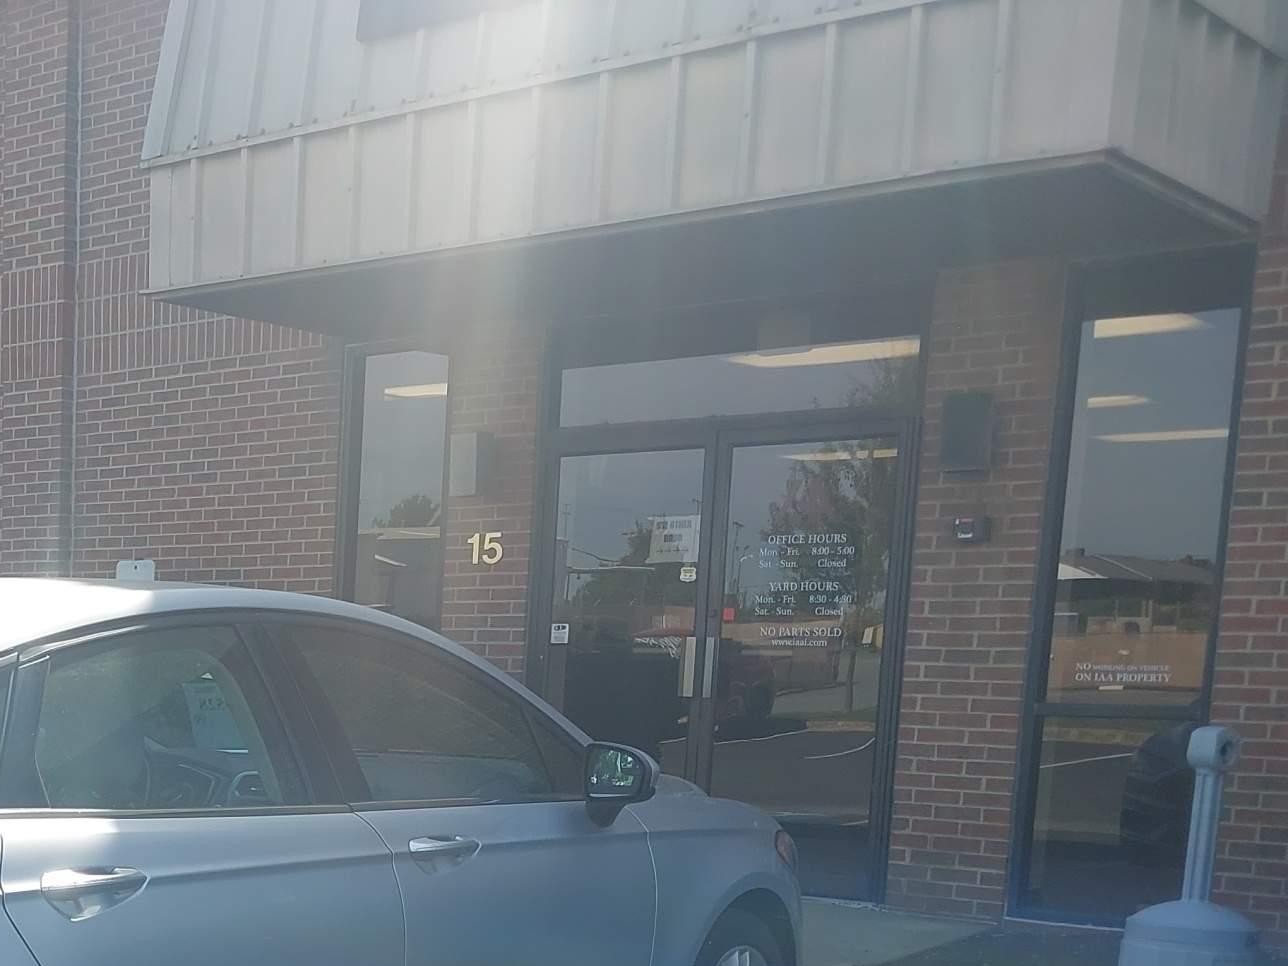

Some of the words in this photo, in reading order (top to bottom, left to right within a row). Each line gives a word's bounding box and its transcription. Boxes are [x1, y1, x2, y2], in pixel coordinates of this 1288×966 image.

[768, 535, 805, 544] OFFICE
[808, 533, 847, 543] HOURS
[467, 531, 503, 565] 15
[812, 546, 829, 555] 8:00
[837, 546, 855, 555] 5:00
[817, 559, 847, 568] Closed
[769, 582, 798, 592] YARD
[800, 581, 840, 591] HOURS
[815, 606, 844, 616] Closed
[760, 627, 776, 637] NO
[778, 627, 811, 637] PARTS
[812, 627, 842, 637] SOLD
[1075, 663, 1092, 671] NO
[1075, 672, 1092, 681] ON
[1094, 672, 1114, 682] IAA
[1116, 672, 1173, 683] PROPERTY
